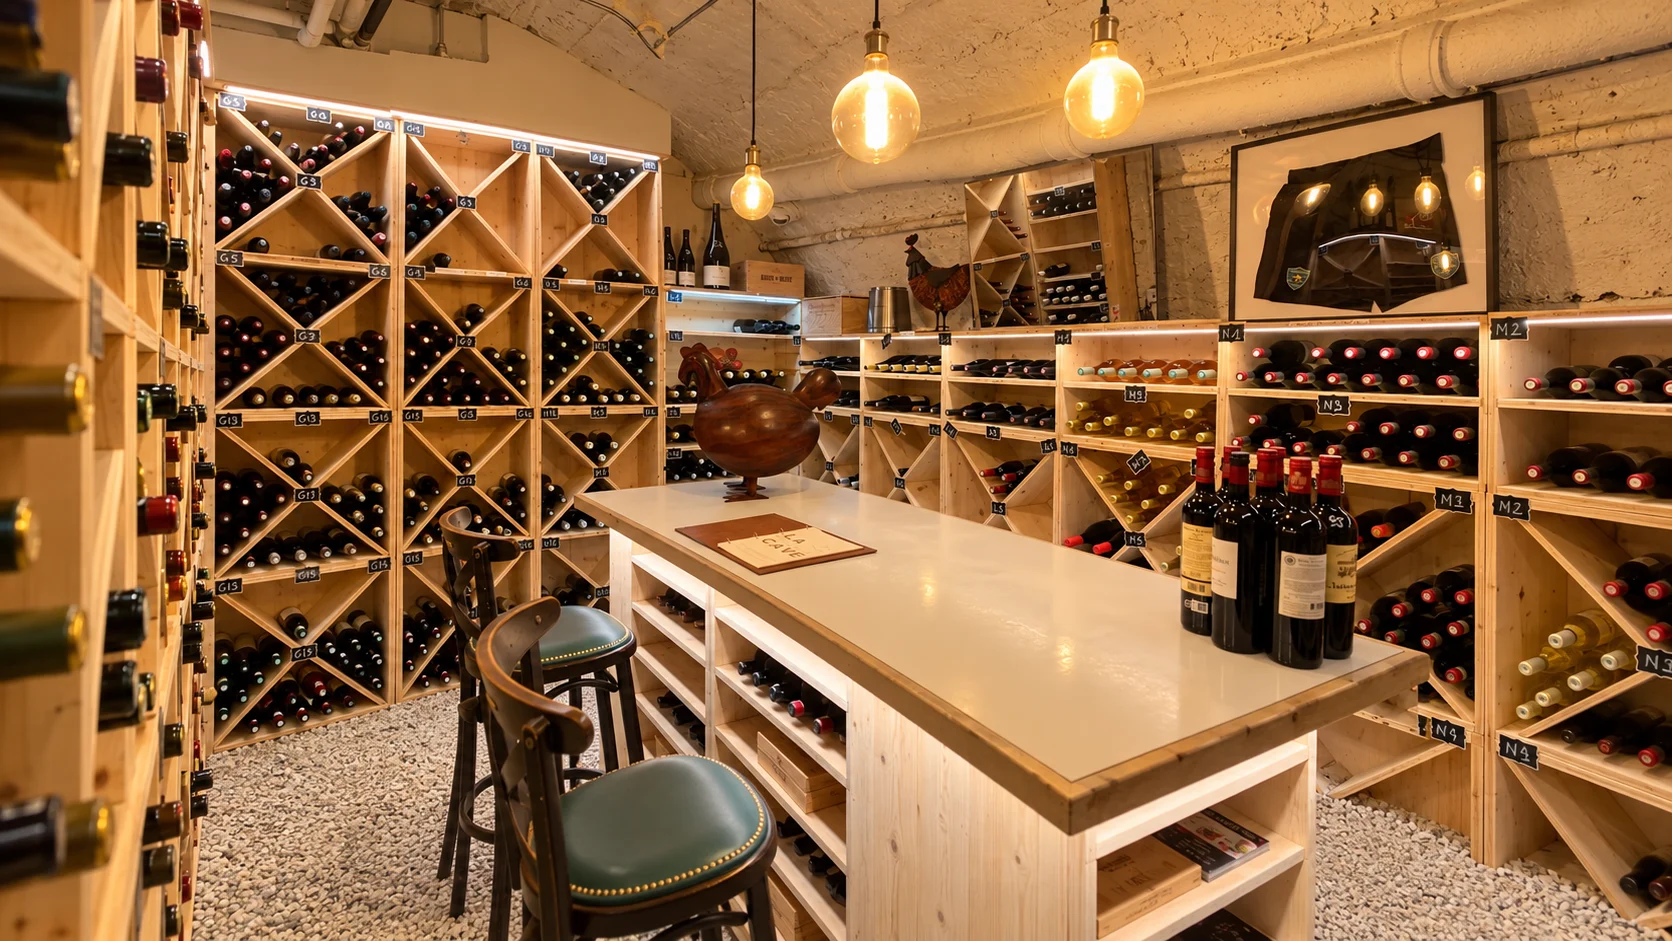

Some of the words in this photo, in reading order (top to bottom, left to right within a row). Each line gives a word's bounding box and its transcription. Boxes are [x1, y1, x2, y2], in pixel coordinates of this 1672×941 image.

[298, 331, 315, 341] G3
[1222, 328, 1241, 340] N1
[1496, 323, 1522, 337] M2
[298, 414, 316, 423] G13
[297, 491, 315, 500] G13
[1499, 501, 1522, 515] M2
[784, 533, 806, 545] LA
[761, 538, 806, 559] CAVE
